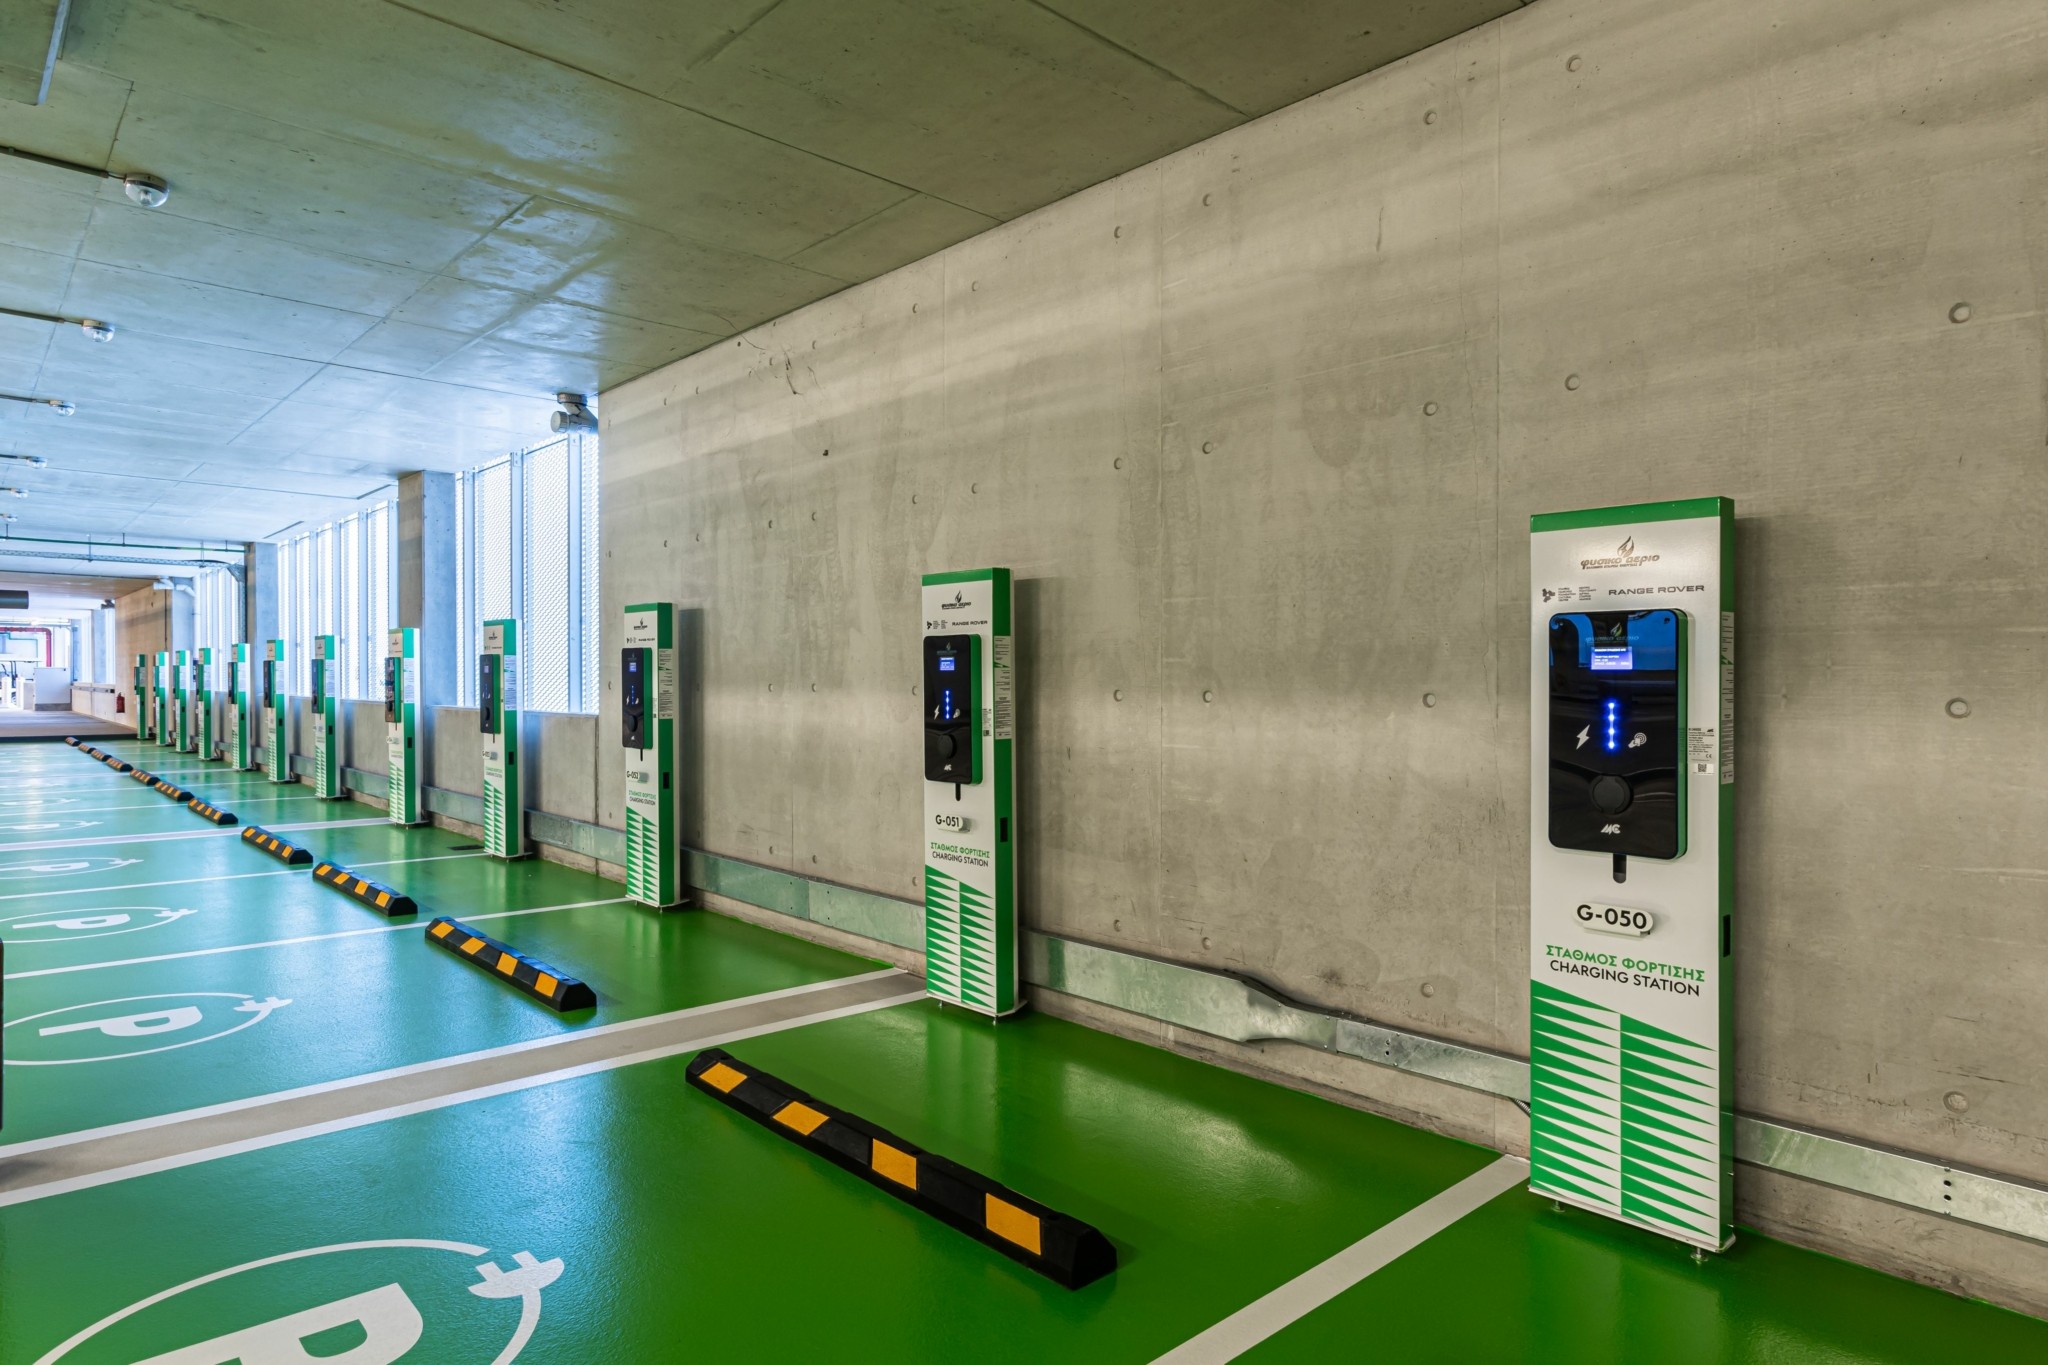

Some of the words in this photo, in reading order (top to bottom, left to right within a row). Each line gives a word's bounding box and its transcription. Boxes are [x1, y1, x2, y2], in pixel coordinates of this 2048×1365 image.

[1608, 587, 1654, 596] RANGE
[1657, 585, 1705, 594] ROVER
[935, 814, 960, 828] G-051
[932, 850, 962, 863] CHARGING
[964, 855, 989, 867] STATION
[1576, 904, 1647, 930] G-050
[1546, 944, 1617, 967] ΣΤΑΘΜΟΣ
[1621, 957, 1705, 982] ΦΟΡΤΙΣΗΣ
[1549, 960, 1629, 984] CHARGING
[1633, 974, 1700, 997] STATION
